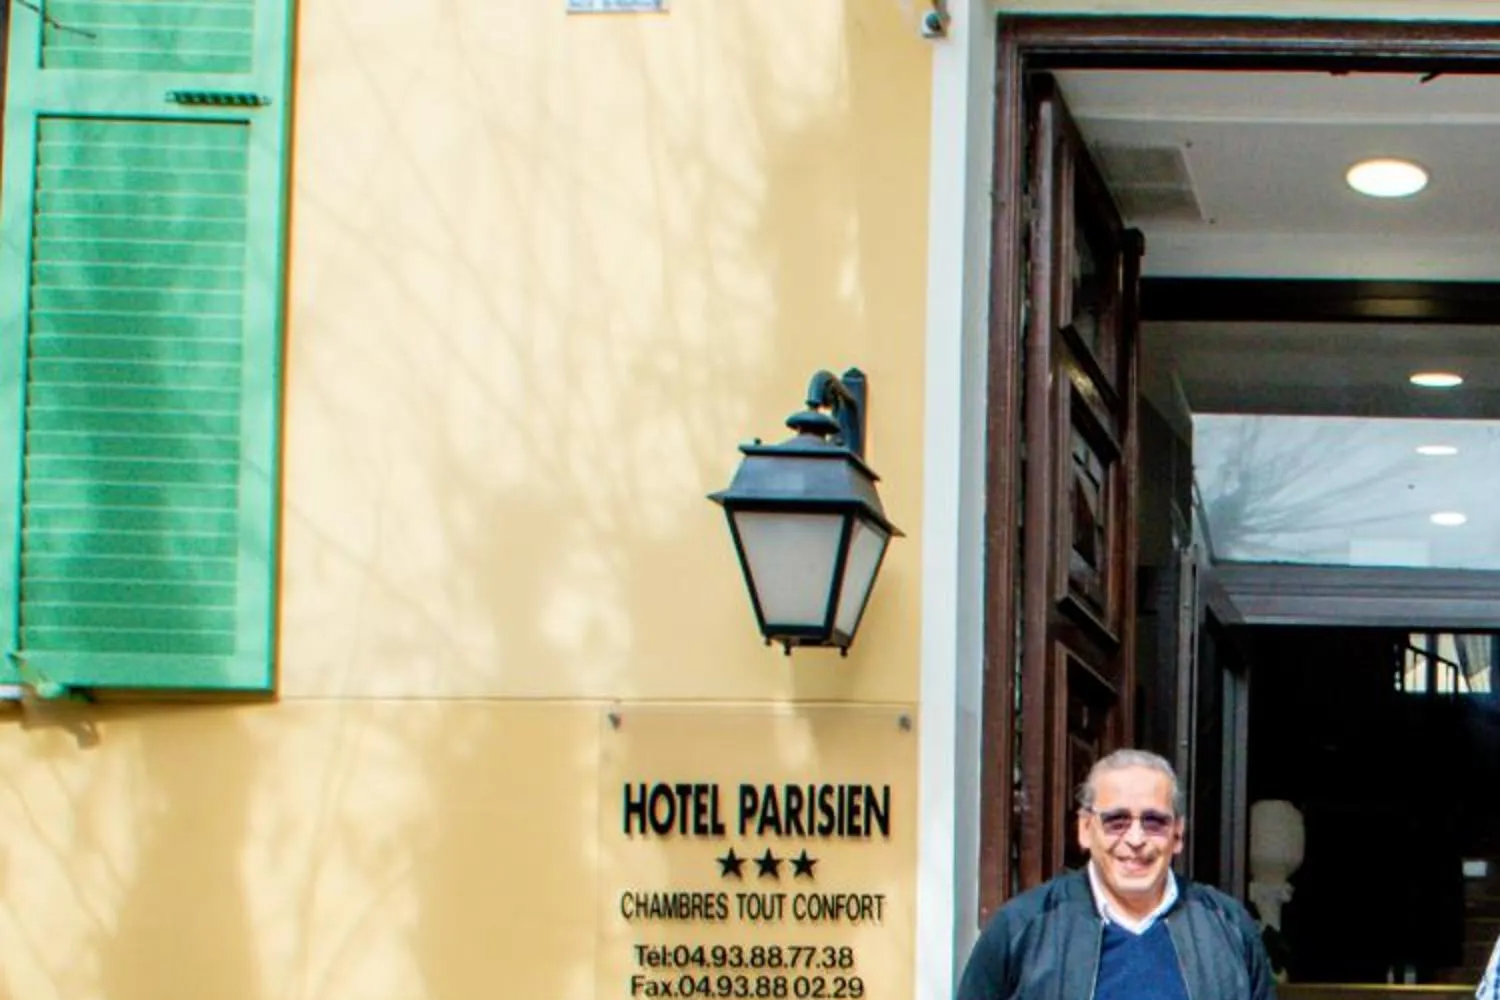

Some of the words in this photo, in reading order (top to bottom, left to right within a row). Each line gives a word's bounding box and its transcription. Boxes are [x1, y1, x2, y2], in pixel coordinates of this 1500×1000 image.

[623, 783, 726, 836] HOTEL
[738, 784, 891, 837] PARISIEN
[620, 891, 729, 920] CHAMBRES
[735, 893, 787, 921] TOUT
[792, 894, 886, 922] CONFORT
